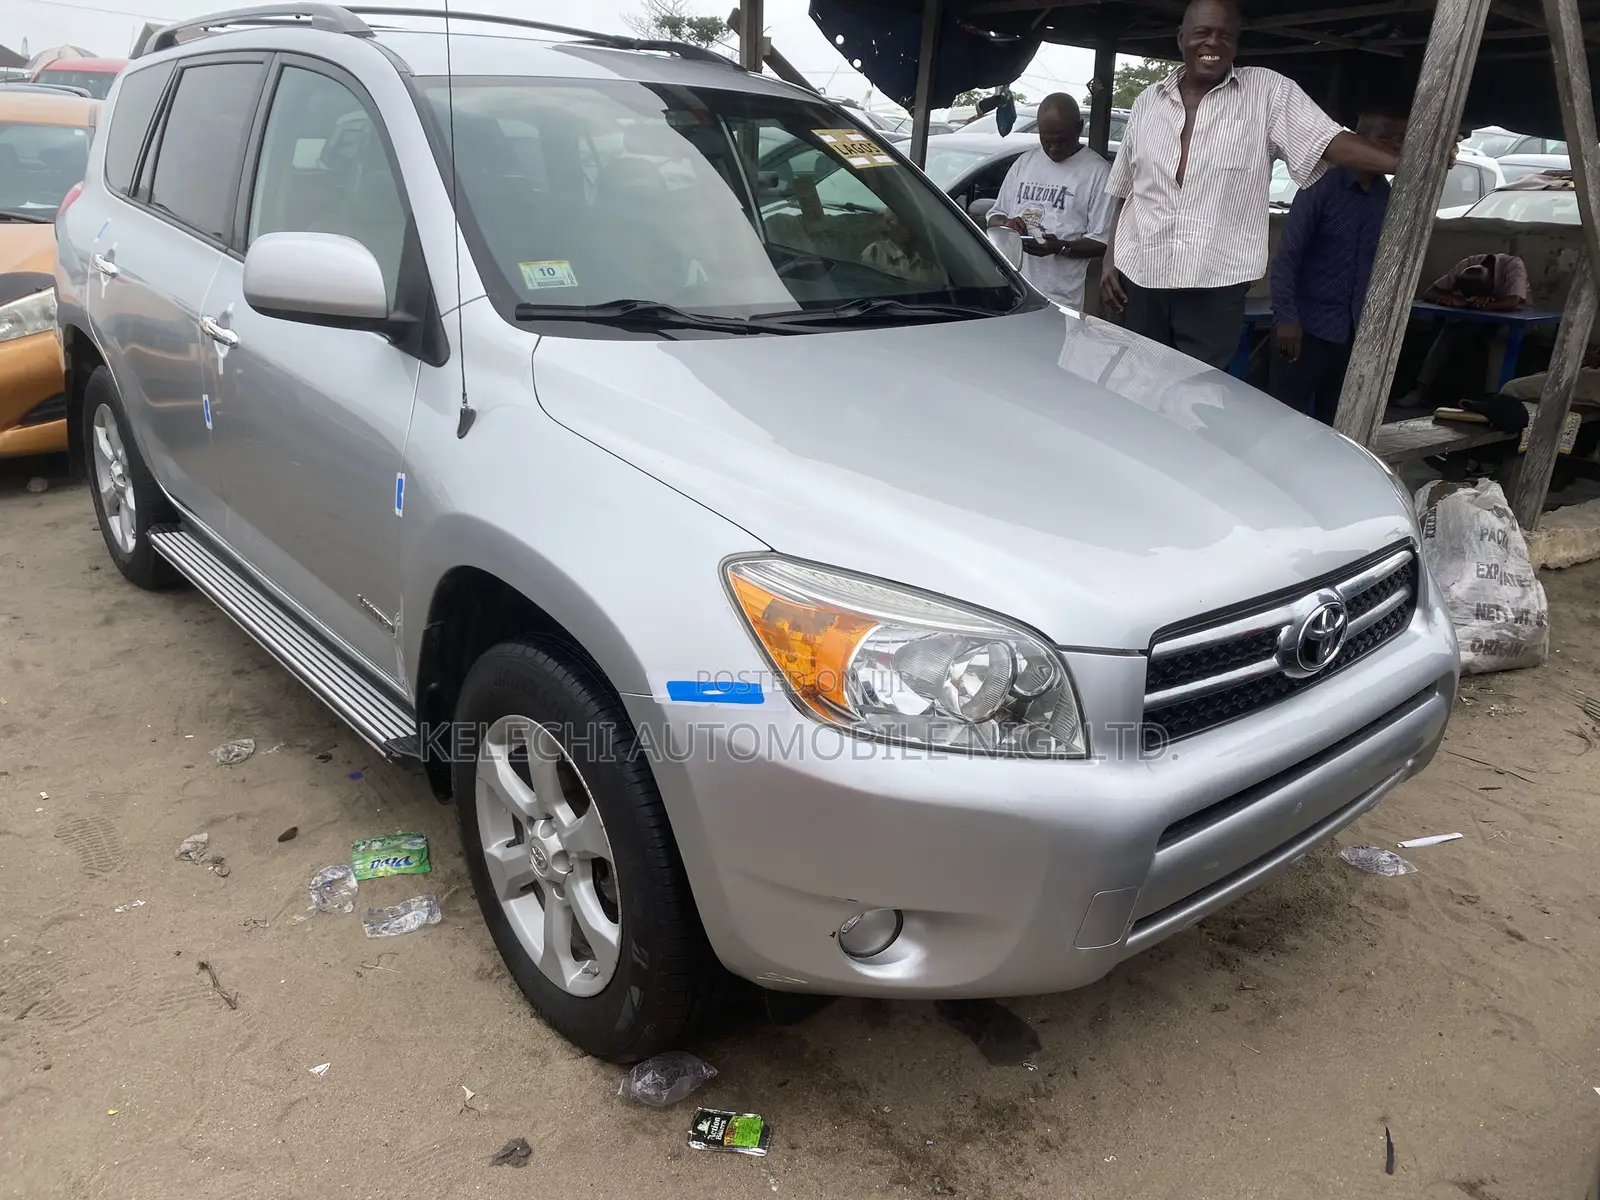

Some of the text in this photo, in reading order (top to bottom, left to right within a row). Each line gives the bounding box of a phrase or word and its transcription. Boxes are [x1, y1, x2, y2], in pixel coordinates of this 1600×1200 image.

[833, 142, 881, 156] LAGOS
[1017, 181, 1069, 210] ARIZONA
[538, 267, 556, 278] 10
[707, 1116, 721, 1140] Action
